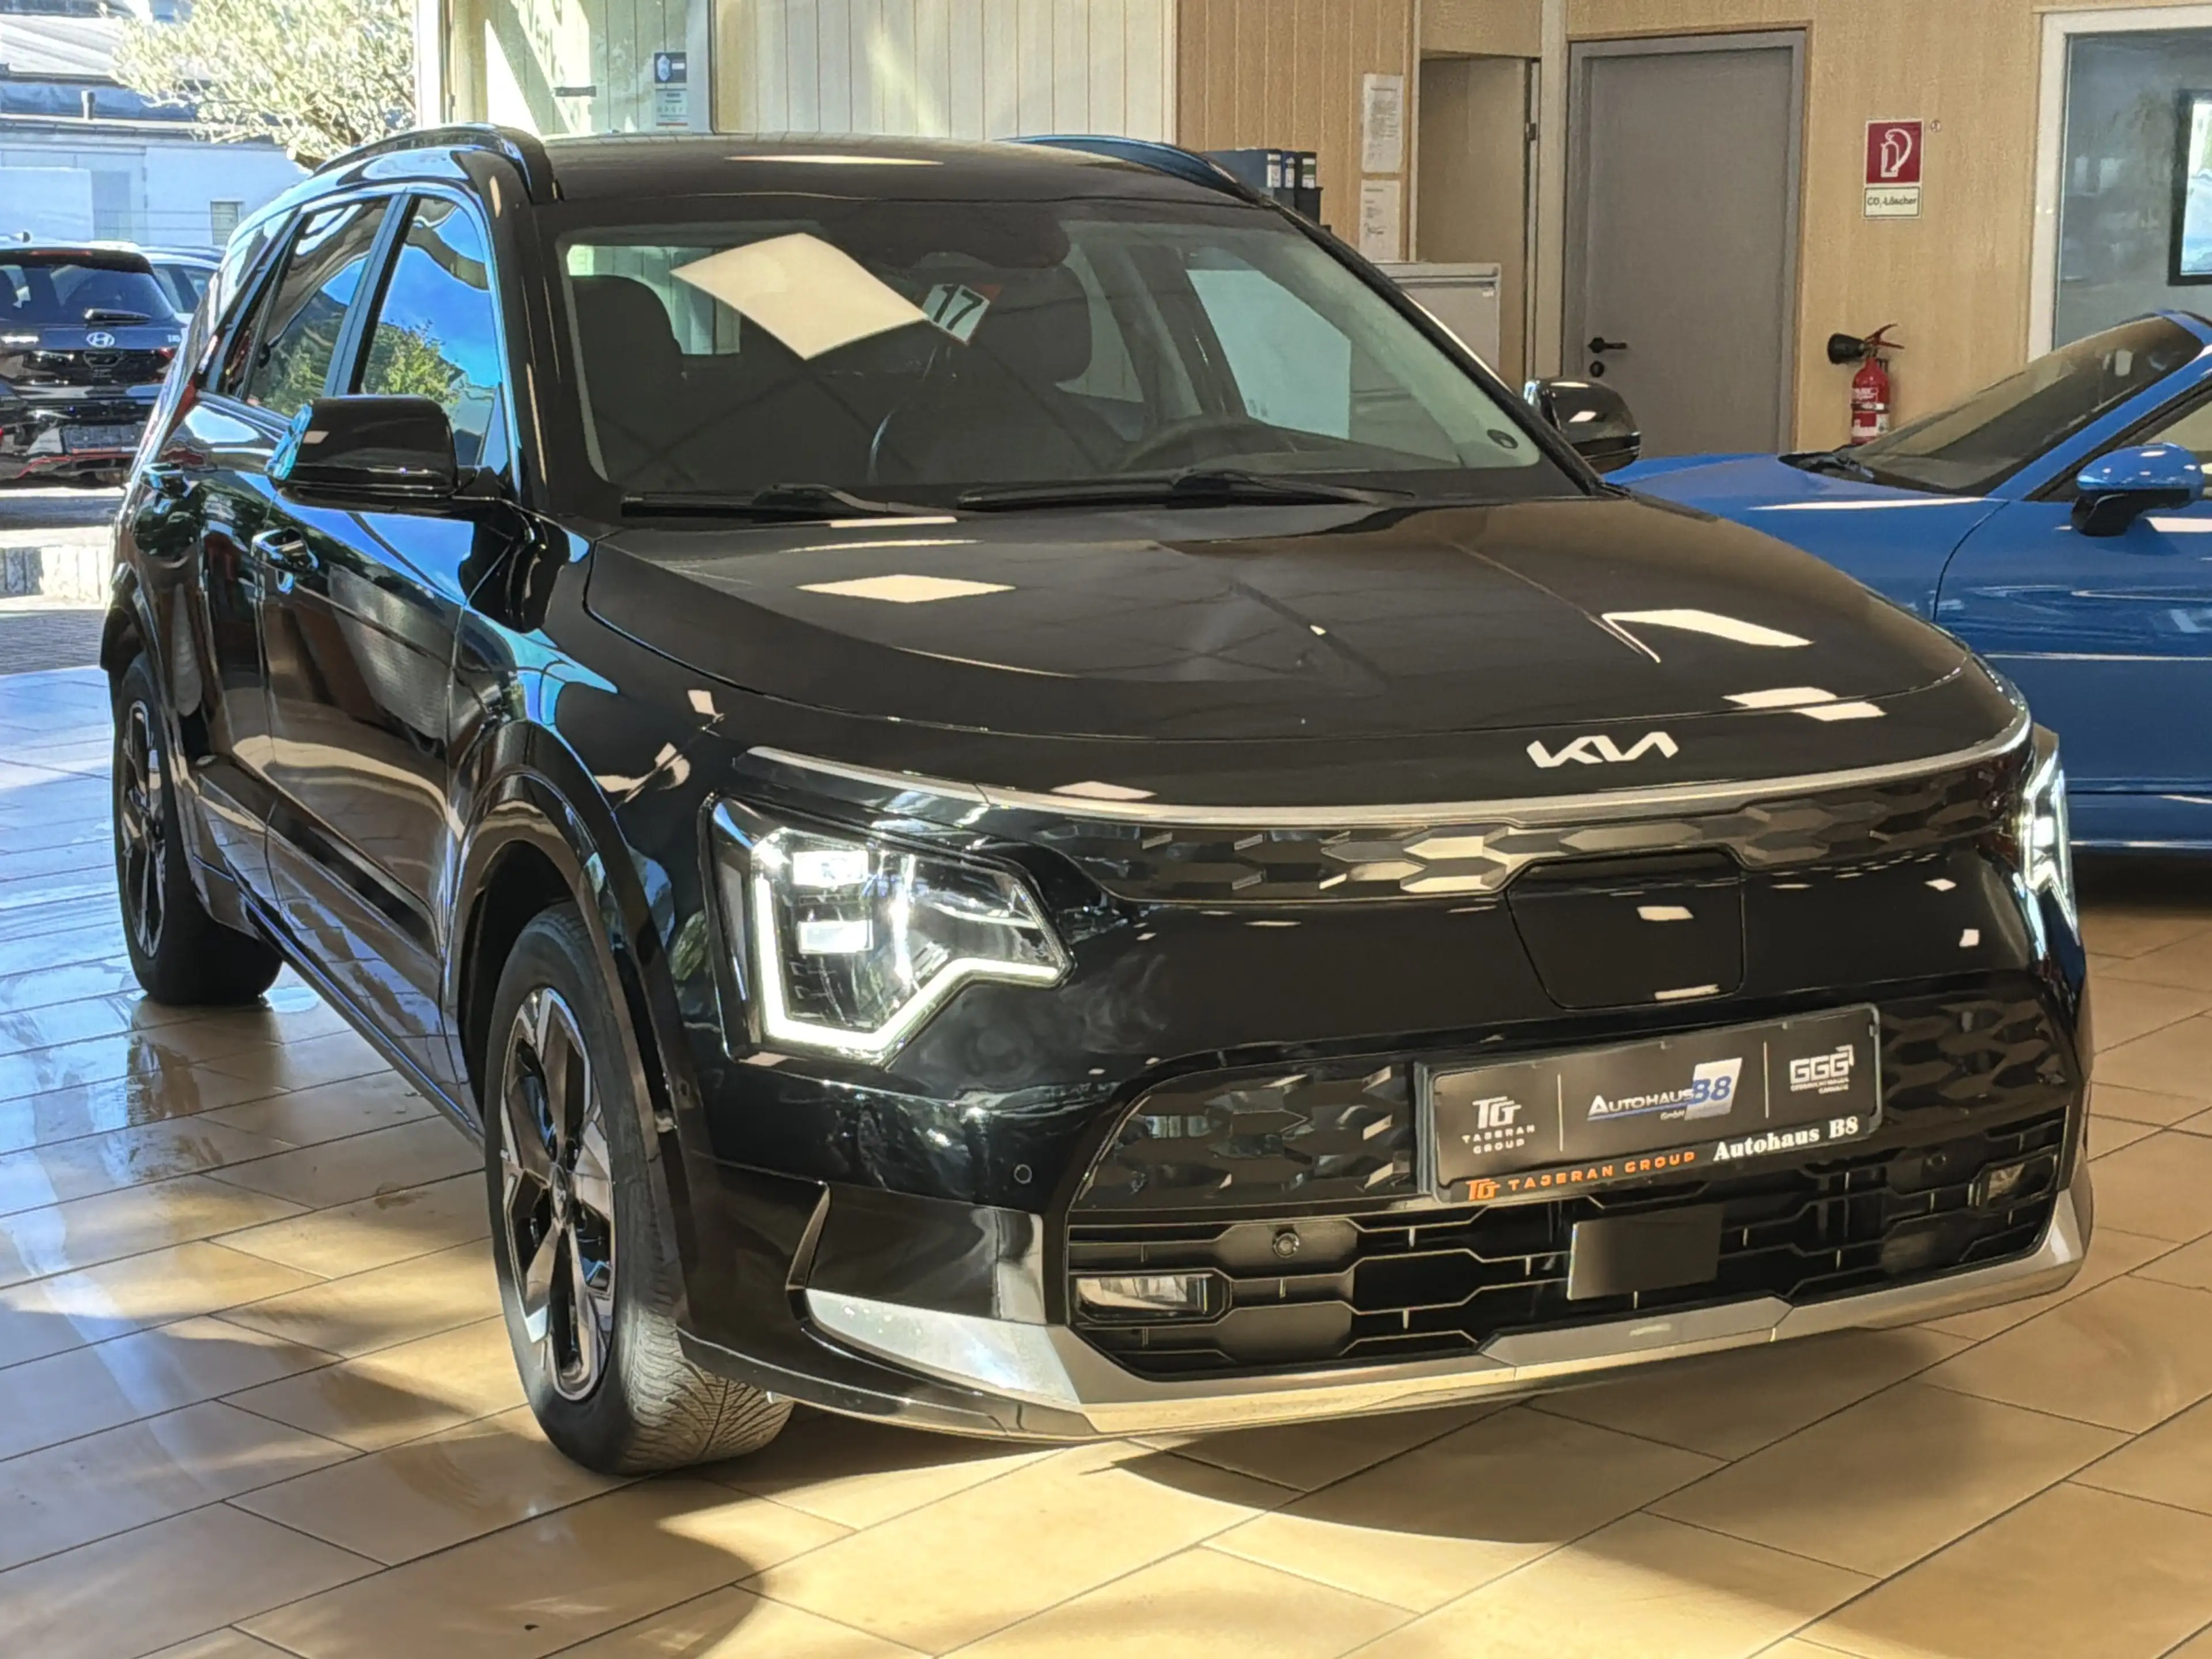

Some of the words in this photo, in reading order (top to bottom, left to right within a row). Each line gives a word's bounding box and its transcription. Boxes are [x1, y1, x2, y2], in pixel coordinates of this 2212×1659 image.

[1527, 731, 1679, 768] KIA
[1473, 1138, 1525, 1155] GROUP
[1713, 1127, 1820, 1162] Autohaus
[1828, 1116, 1859, 1139] B8
[1624, 1152, 1695, 1173] GROUP
